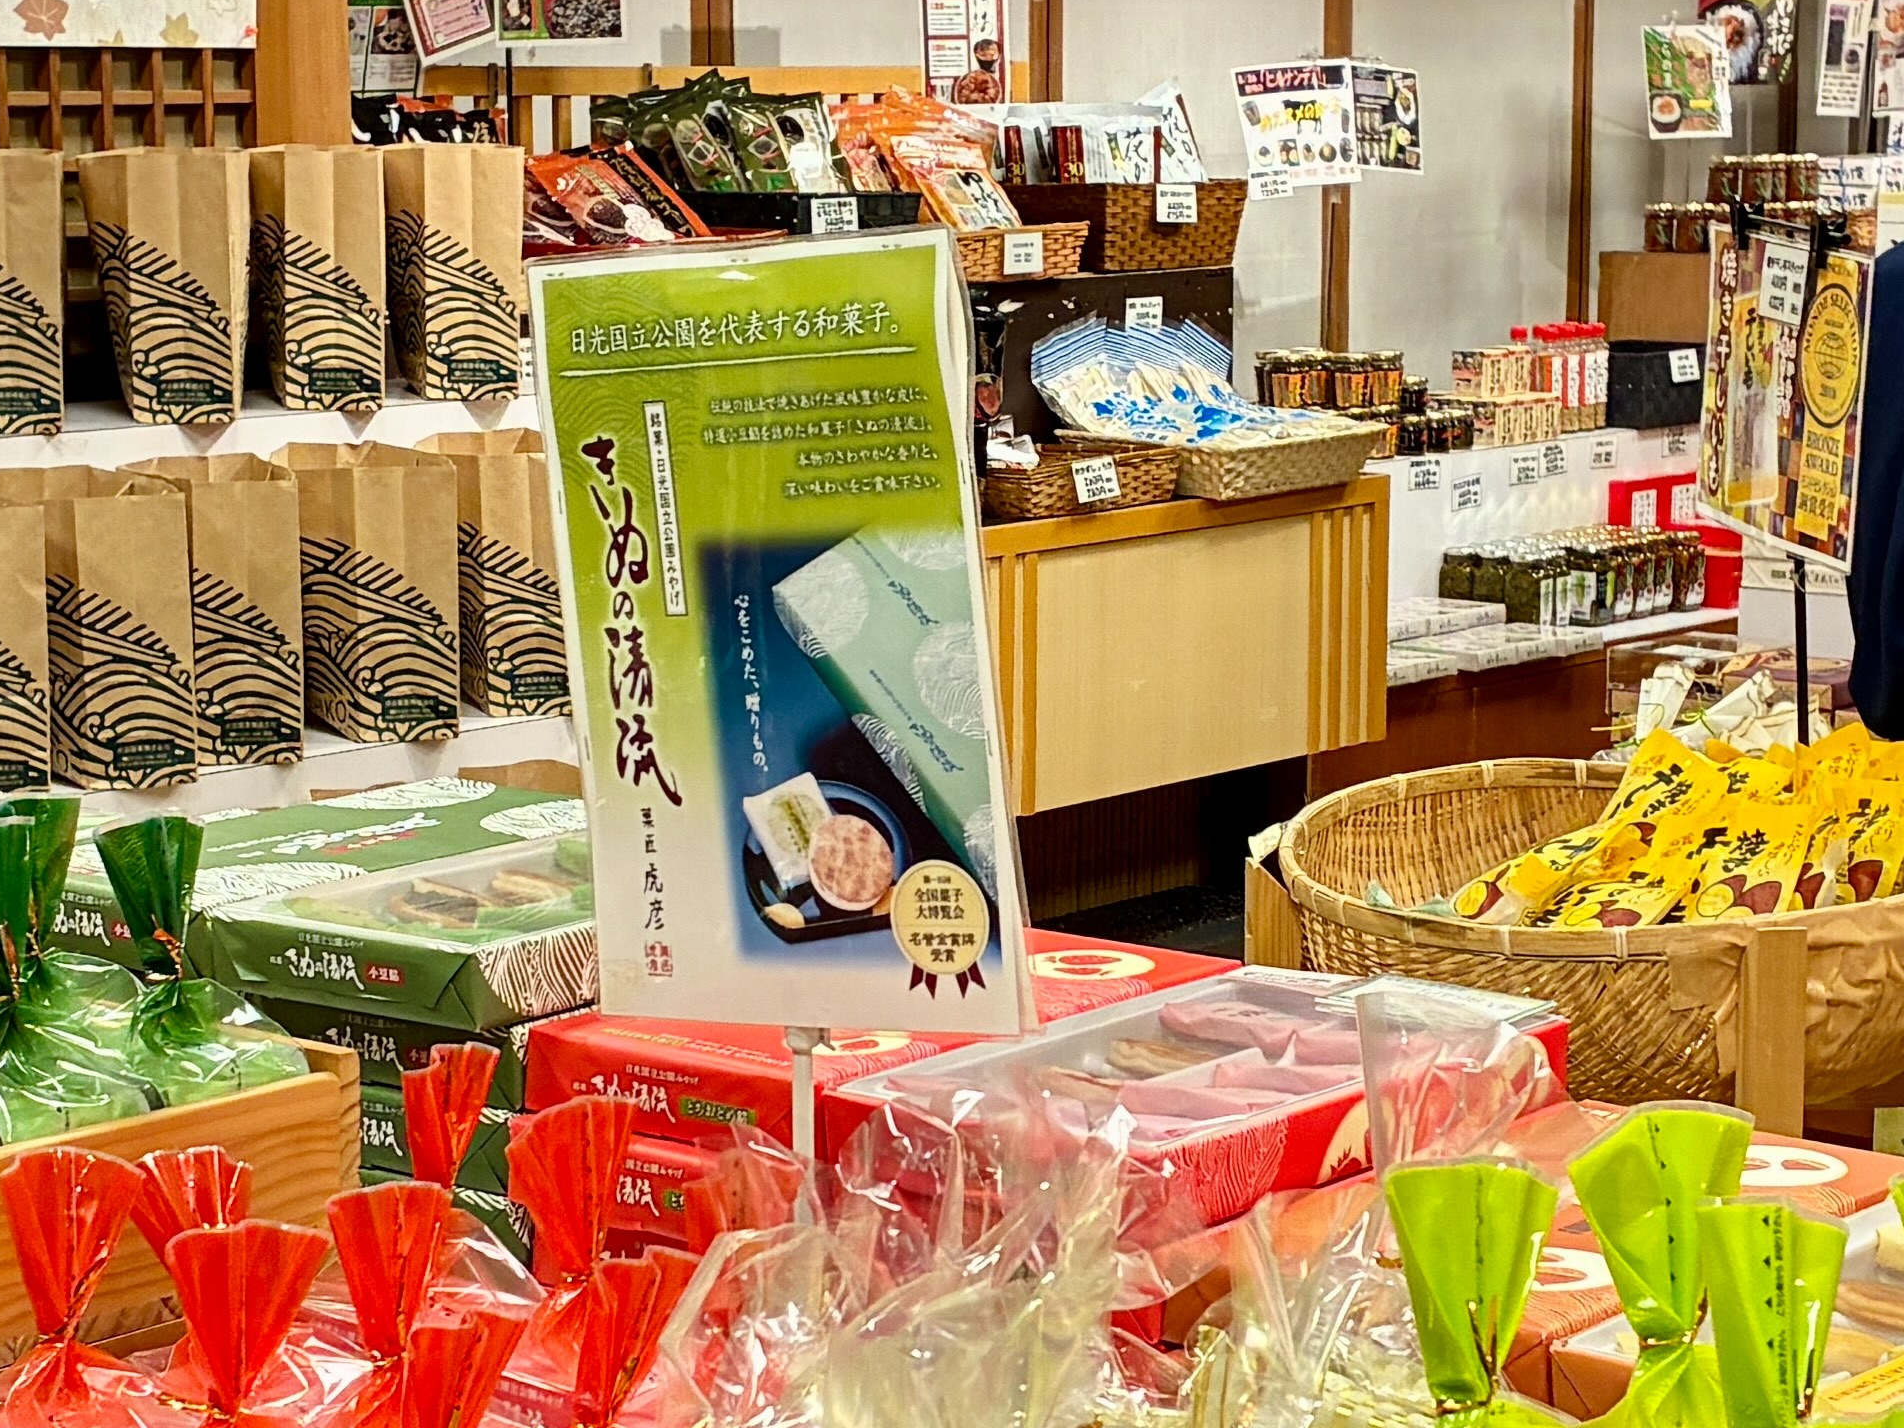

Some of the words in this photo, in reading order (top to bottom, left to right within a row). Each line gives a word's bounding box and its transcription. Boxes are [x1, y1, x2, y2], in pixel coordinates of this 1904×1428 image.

[571, 301, 900, 356] 日光国立公園を代表する和菓子。
[1804, 461, 1839, 476] AWARD
[580, 435, 683, 808] きぬの清流
[283, 944, 365, 991] きぬの清流
